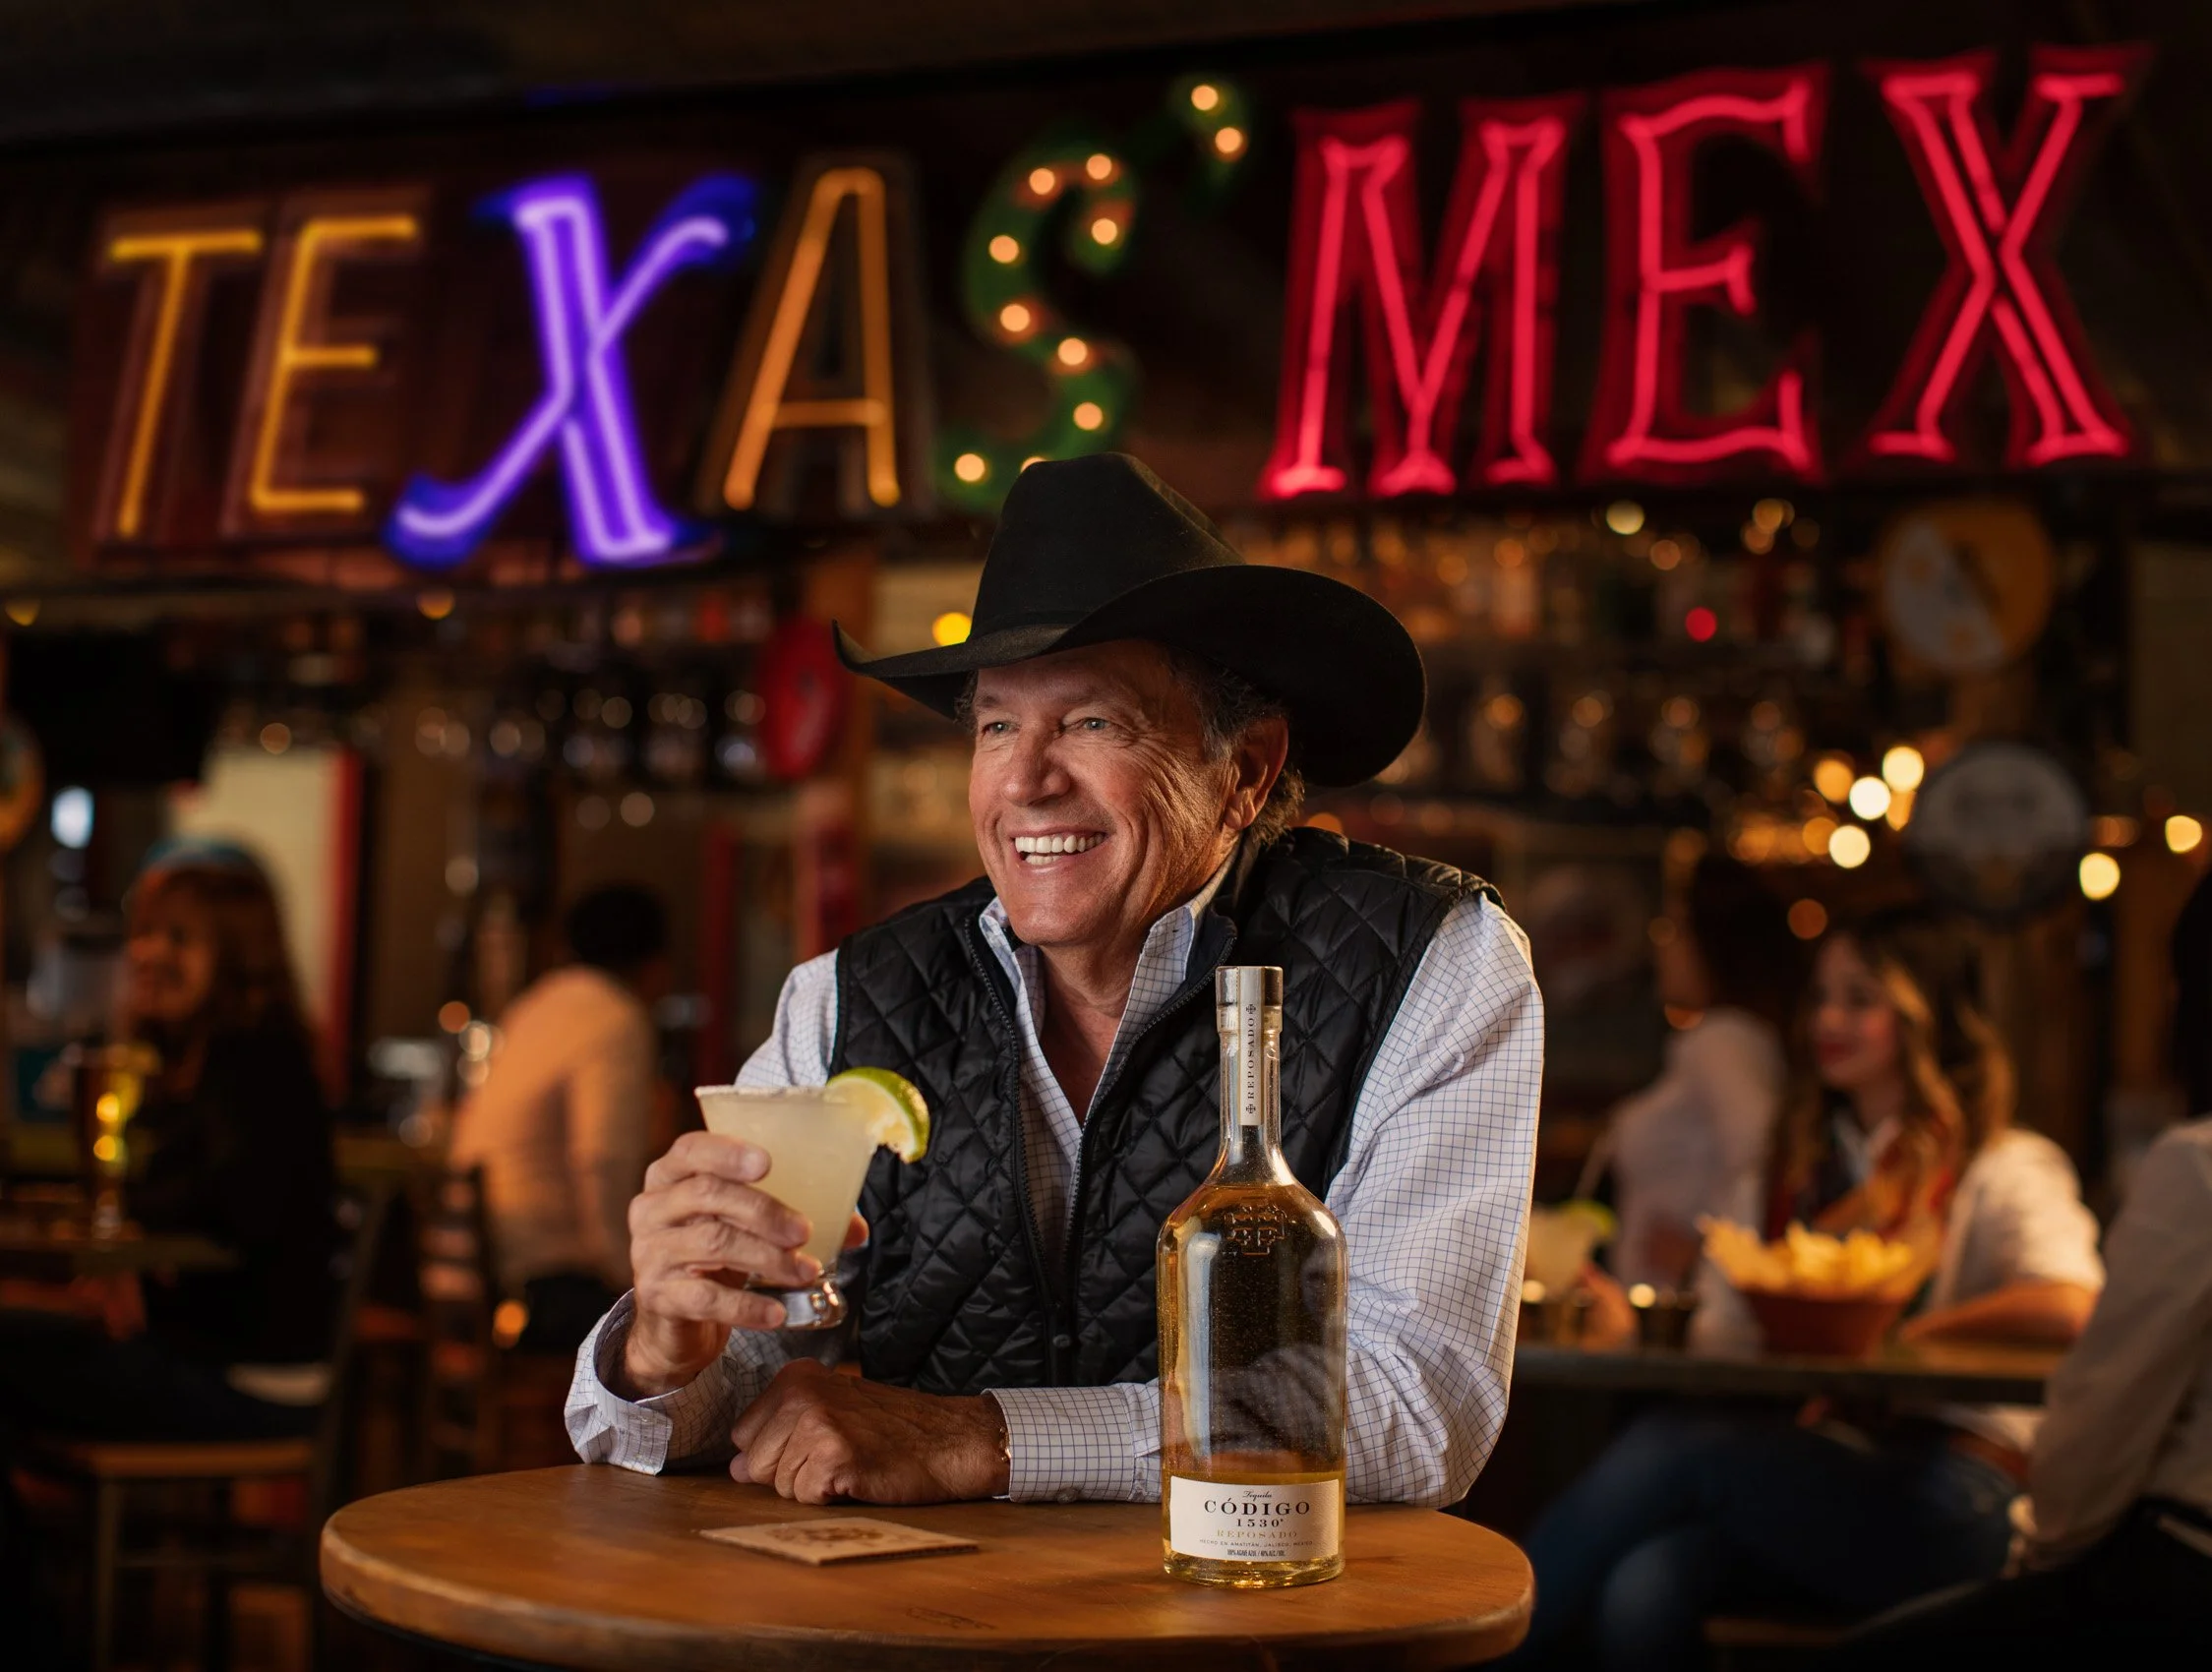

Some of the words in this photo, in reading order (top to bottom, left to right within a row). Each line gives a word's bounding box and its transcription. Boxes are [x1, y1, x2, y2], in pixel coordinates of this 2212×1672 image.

[95, 75, 1251, 568] TEXAS
[1261, 43, 2150, 500] MEX
[1242, 1490, 1273, 1502] Tequila
[1204, 1497, 1310, 1516] CÓDIGO
[1217, 1528, 1297, 1539] REPOSADO
